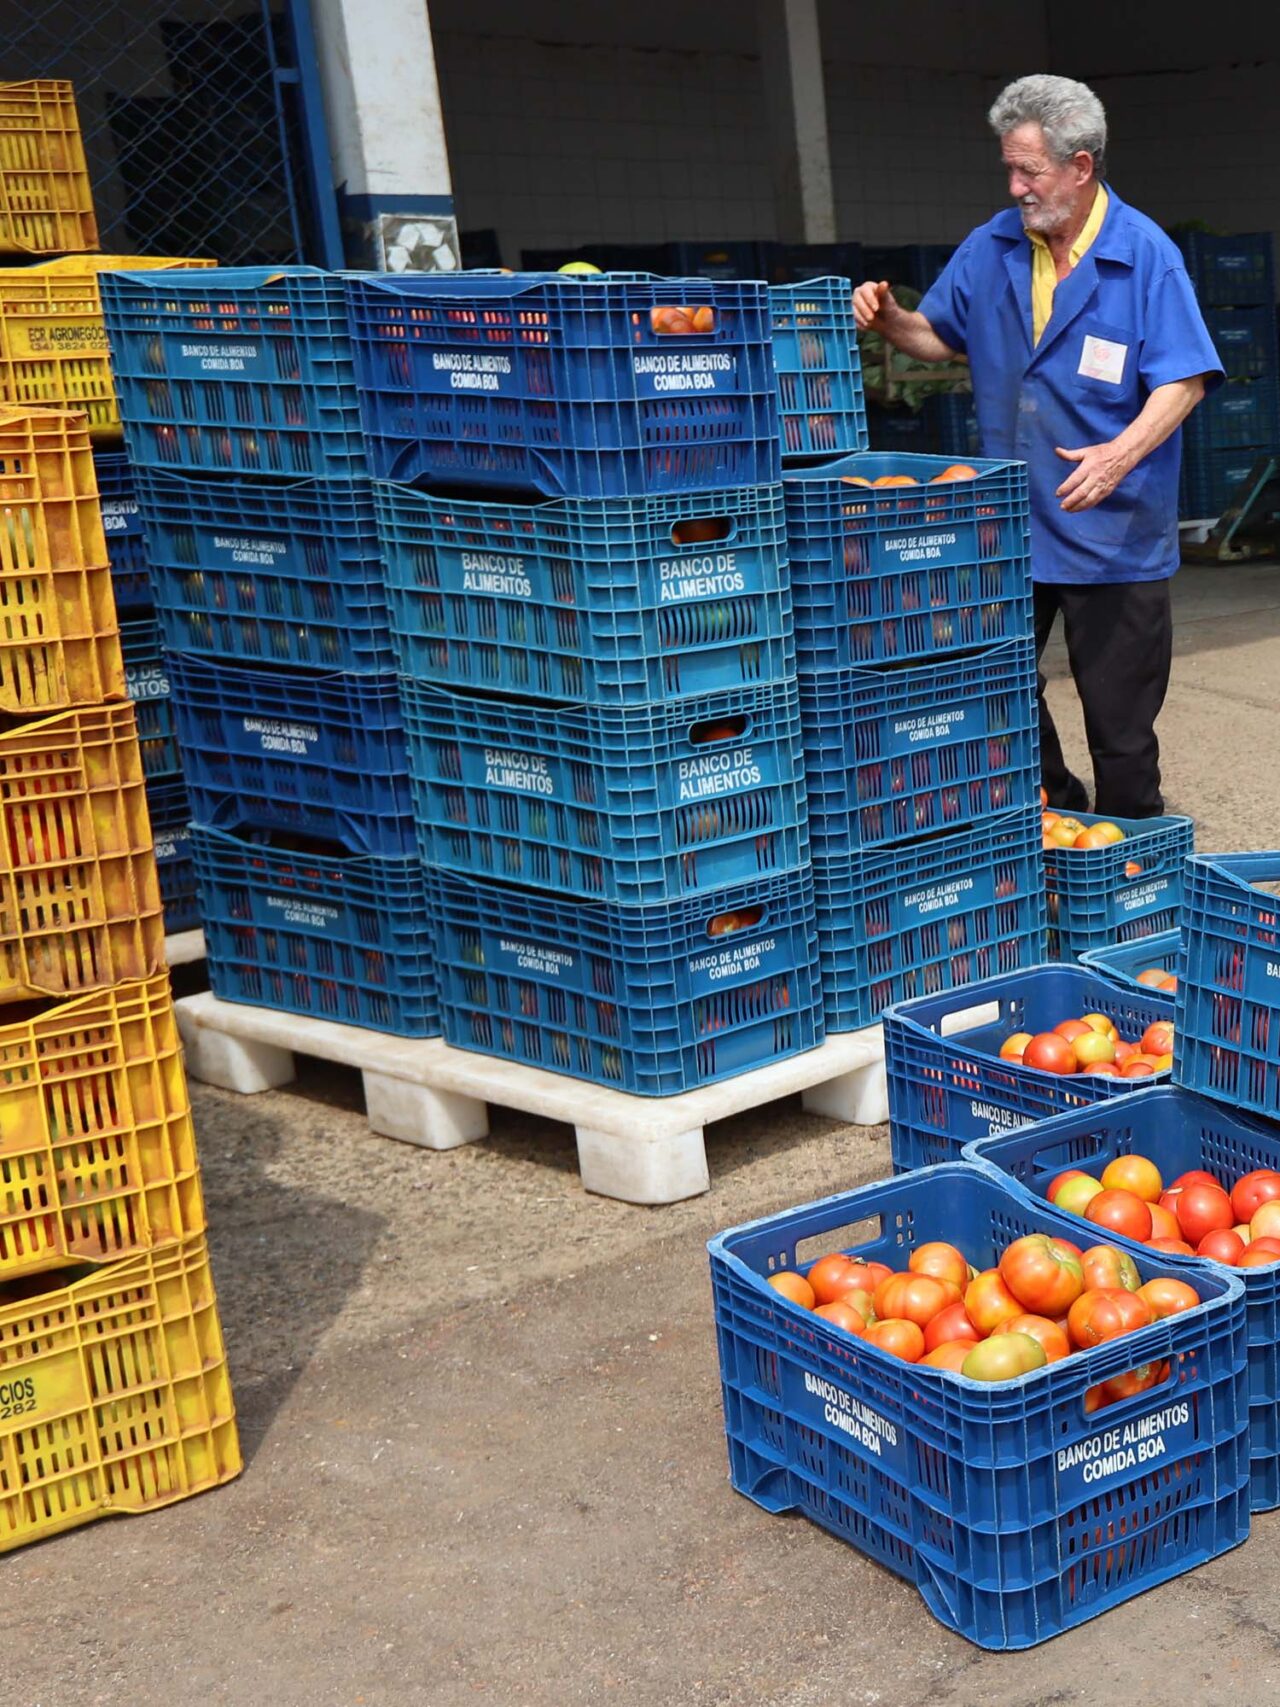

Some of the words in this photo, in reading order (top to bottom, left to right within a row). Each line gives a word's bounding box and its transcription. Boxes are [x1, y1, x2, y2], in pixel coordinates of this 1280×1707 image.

[182, 346, 209, 357] BANCO
[210, 346, 219, 357] DE
[221, 346, 257, 358] ALIMENTOS
[433, 353, 460, 371] BANCO
[461, 355, 473, 371] DE
[473, 356, 511, 374] ALIMENTOS
[634, 356, 667, 373] BANCO
[668, 355, 680, 372] DE
[682, 354, 731, 371] ALIMENTOS
[202, 359, 229, 370] COMIDA
[230, 359, 245, 370] BOA
[451, 373, 482, 389] COMIDA
[483, 375, 499, 390] BOA
[654, 374, 692, 391] COMIDA
[694, 373, 716, 389] BOA
[104, 516, 128, 530] BOA
[885, 540, 907, 552] BANCO
[908, 538, 917, 548] DE
[920, 533, 956, 547] ALIMENTOS
[900, 549, 926, 561] COMIDA
[927, 548, 942, 559] BOA
[461, 553, 506, 573] BANCO
[510, 558, 525, 576] DE
[660, 557, 714, 580] BANCO
[717, 554, 737, 573] DE
[463, 572, 532, 597] ALIMENTOS
[661, 573, 745, 601] ALIMENTOS
[244, 717, 270, 734] BANCO
[271, 721, 282, 736] DE
[283, 722, 318, 742] ALIMENTOS
[895, 719, 916, 734] BANCO
[917, 717, 926, 728] DE
[927, 710, 965, 728] ALIMENTOS
[909, 728, 935, 742] COMIDA
[936, 725, 950, 737] BOA
[261, 735, 290, 751] COMIDA
[291, 740, 308, 754] BOA
[485, 749, 529, 770] BANCO
[533, 756, 548, 775] DE
[680, 754, 731, 779] BANCO
[734, 749, 753, 768] DE
[486, 768, 553, 795] ALIMENTOS
[680, 766, 761, 801] ALIMENTOS
[904, 891, 926, 907] BANCO
[927, 888, 936, 900] DE
[937, 878, 974, 896] ALIMENTOS
[919, 898, 944, 914] COMIDA
[945, 894, 959, 906] BOA
[1114, 890, 1131, 904] ANCO
[1131, 889, 1139, 899] DE
[1139, 880, 1168, 896] ALIMENTOS
[1124, 899, 1145, 911] COMIDA
[1146, 893, 1156, 905] BOA
[500, 940, 526, 954] BANCO
[527, 945, 537, 957] DE
[537, 947, 573, 968] ALIMENTOS
[518, 956, 545, 972] COMIDA
[545, 961, 560, 976] BOA
[690, 955, 718, 972] BANCO
[720, 951, 731, 964] DE
[733, 939, 776, 961] ALIMENTOS
[709, 963, 742, 980] COMIDA
[744, 957, 761, 971] BOA
[971, 1101, 1001, 1123] BANCO
[1001, 1108, 1012, 1126] DE
[805, 1372, 838, 1404] BANCO
[839, 1390, 851, 1411] DE
[852, 1399, 897, 1446] ALIMENTOS
[825, 1404, 861, 1441] COMIDA
[862, 1427, 881, 1457] BOA
[1057, 1437, 1101, 1472] BANCO
[1104, 1429, 1121, 1453] DE
[1123, 1402, 1189, 1444] ALIMENTOS
[1083, 1447, 1137, 1483] COMIDA
[1139, 1436, 1166, 1463] BOA
